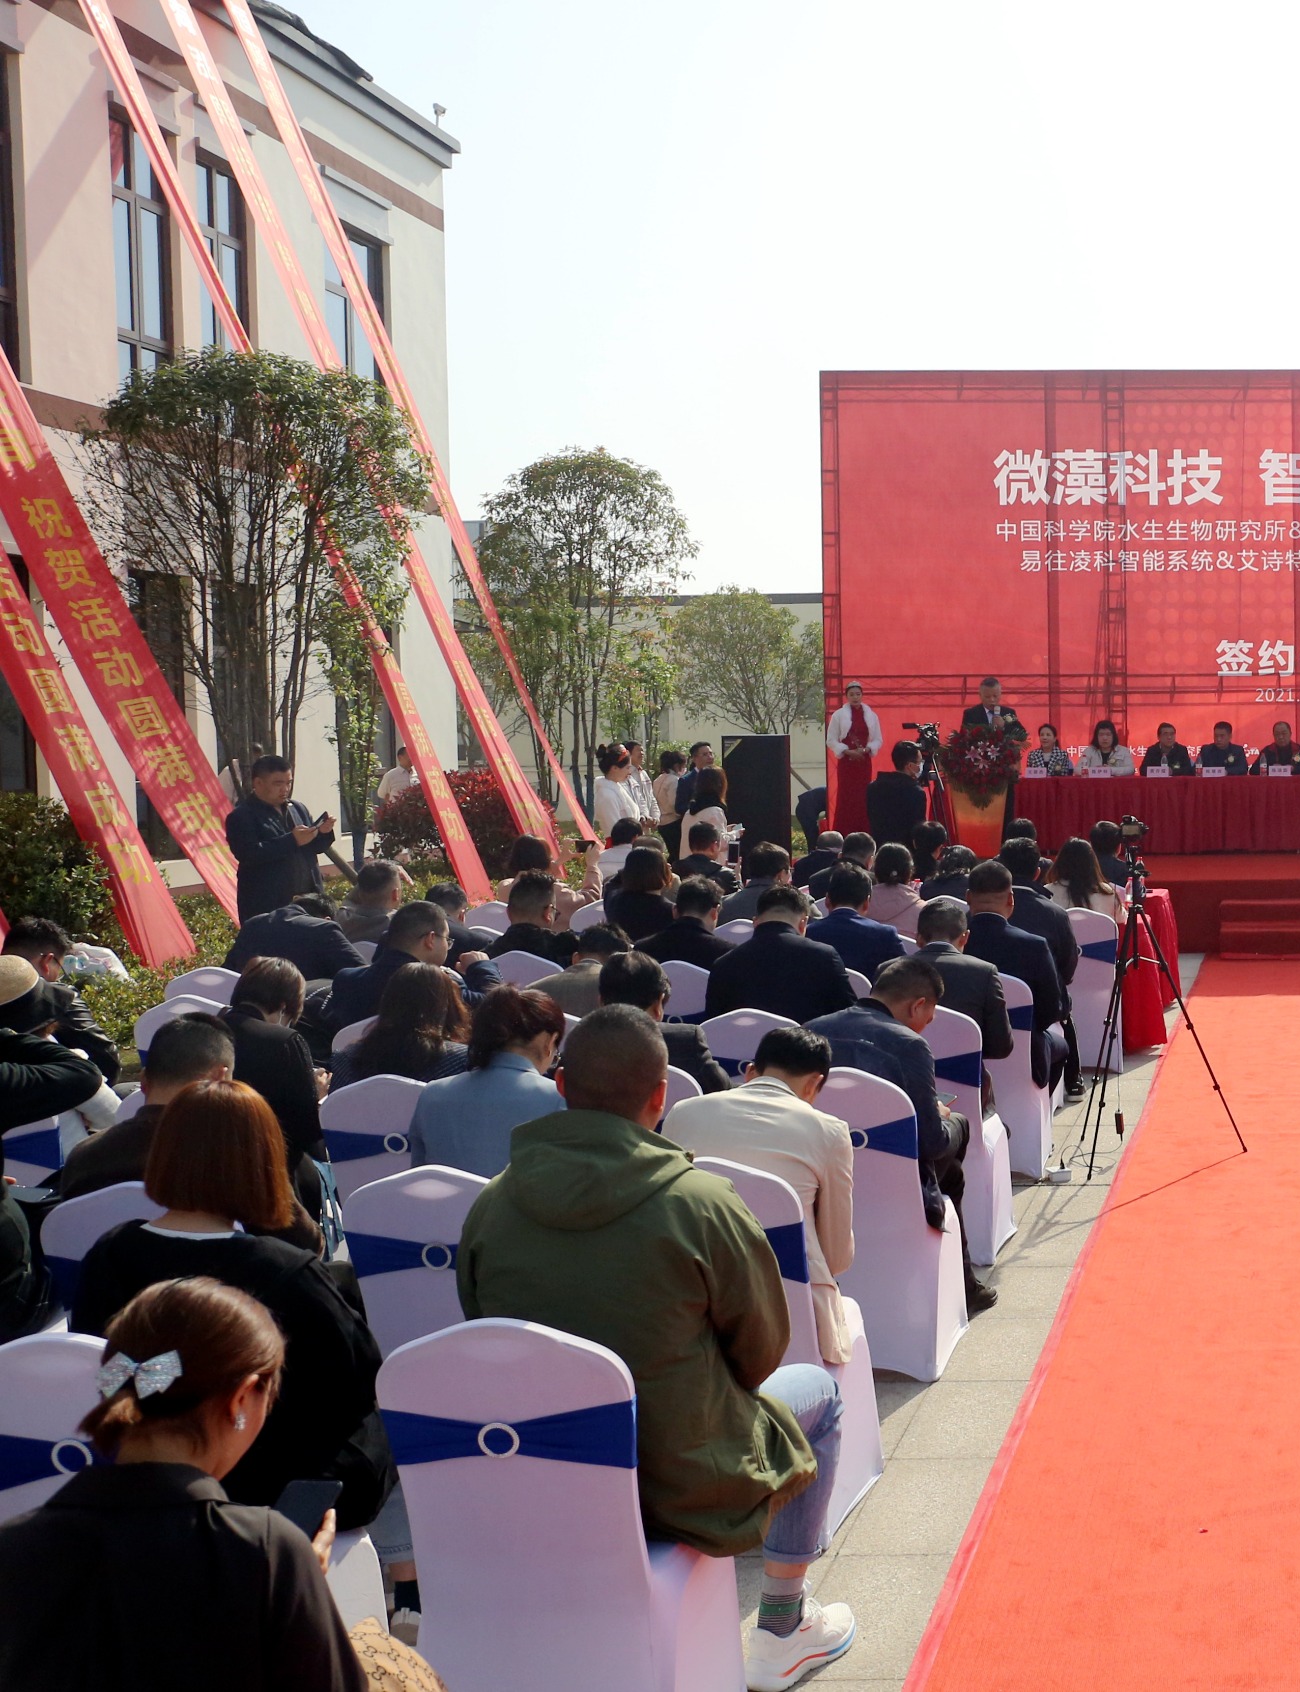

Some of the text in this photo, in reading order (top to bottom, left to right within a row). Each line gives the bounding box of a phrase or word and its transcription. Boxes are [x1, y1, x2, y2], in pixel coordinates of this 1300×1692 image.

[993, 448, 1223, 505] 微藻科技
[21, 497, 235, 879] 祝贺活动圆满成功
